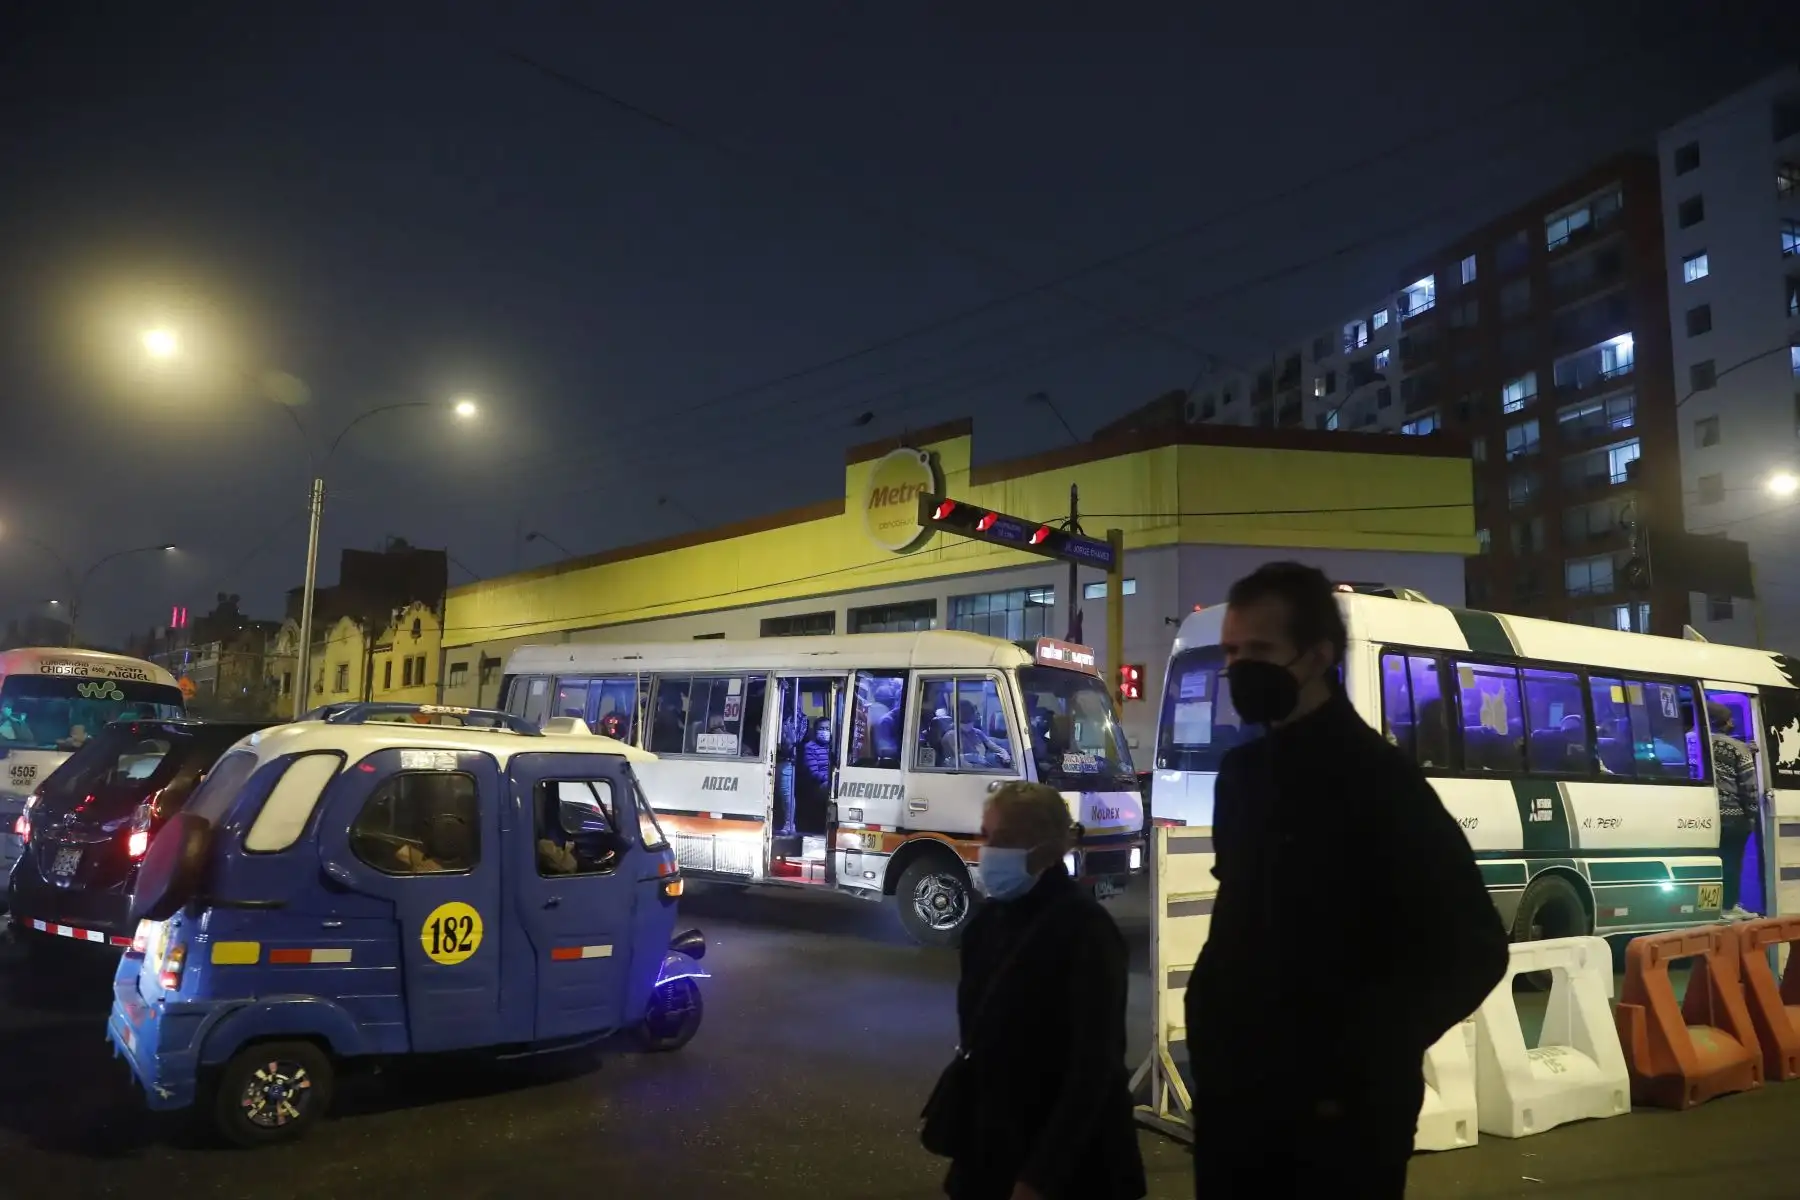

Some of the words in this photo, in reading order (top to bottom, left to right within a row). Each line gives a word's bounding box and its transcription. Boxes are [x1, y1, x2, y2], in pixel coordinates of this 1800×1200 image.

[724, 703, 739, 718] 30
[10, 766, 36, 778] 4505
[702, 776, 738, 791] ARICA
[430, 915, 473, 955] 182
